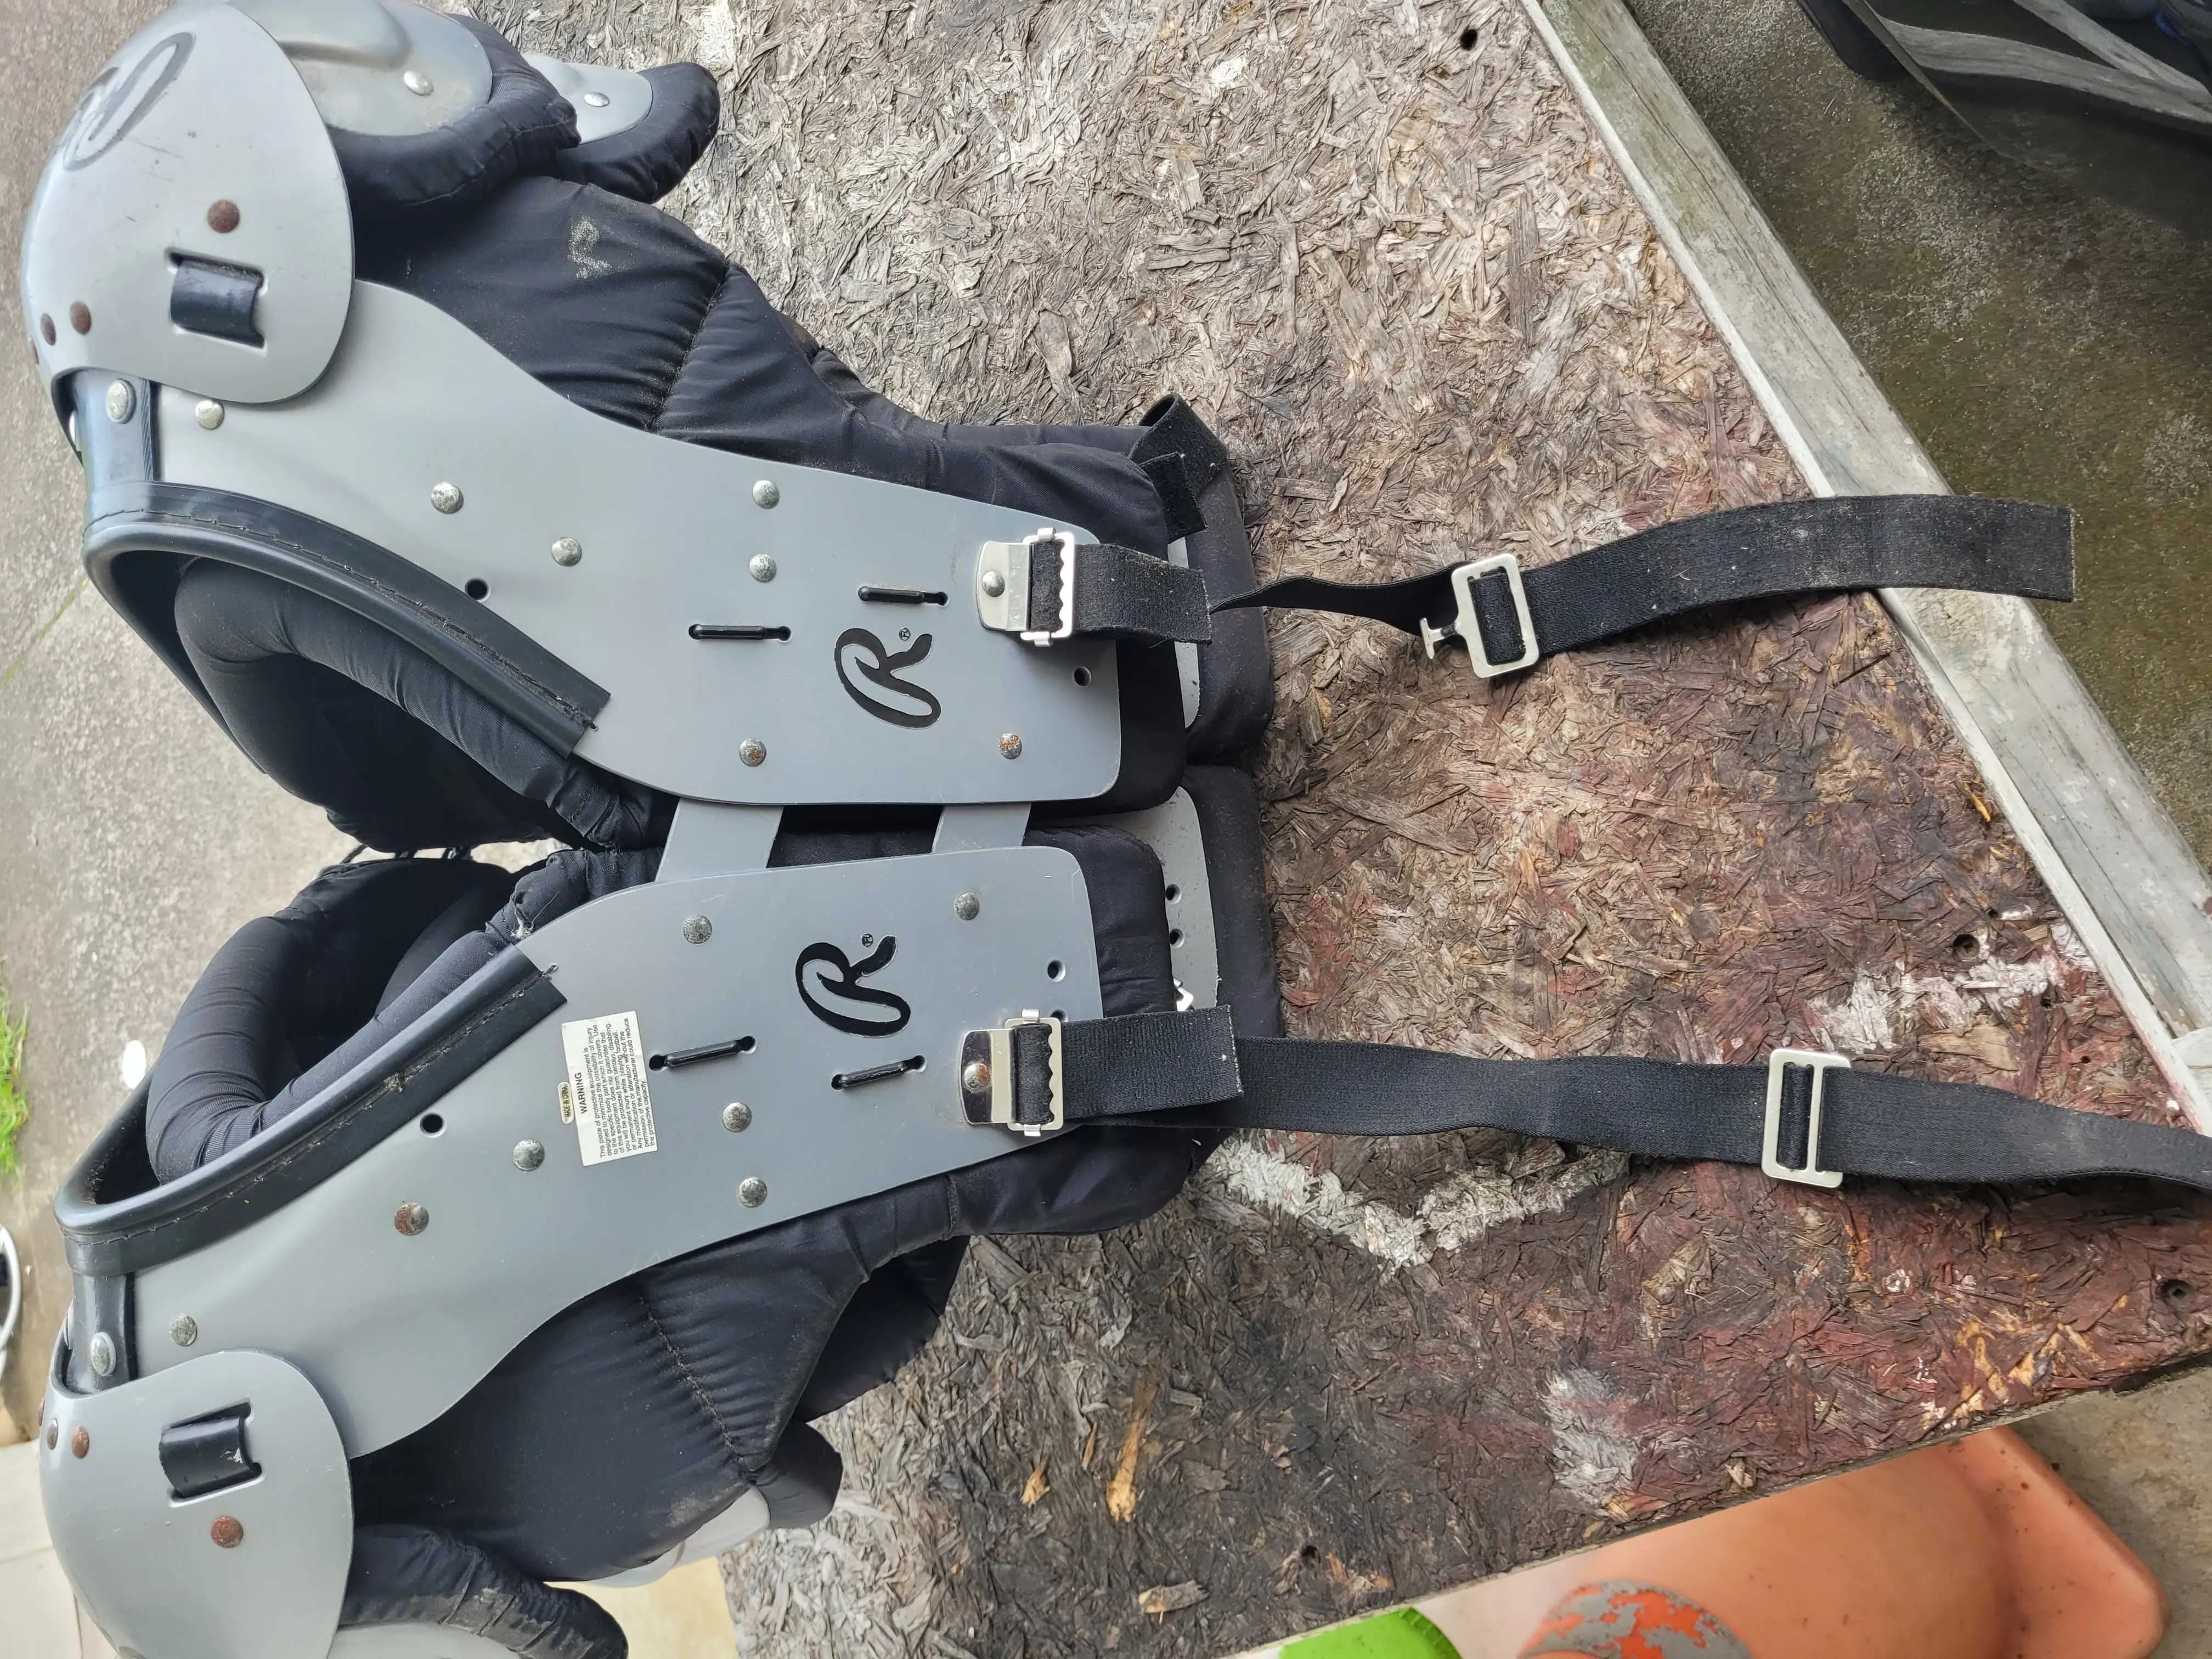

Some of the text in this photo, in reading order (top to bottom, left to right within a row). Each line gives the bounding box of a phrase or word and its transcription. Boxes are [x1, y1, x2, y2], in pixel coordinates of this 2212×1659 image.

[590, 1052, 601, 1081] possibility
[602, 1045, 613, 1074] guarantee
[617, 1054, 627, 1076] playing
[625, 1064, 634, 1091] alteration
[561, 1086, 569, 1099] CHINA
[574, 1072, 588, 1114] WARNING
[591, 1090, 601, 1119] protective
[598, 1093, 606, 1120] minimize
[605, 1098, 613, 1113] body
[616, 1091, 627, 1119] protected
[641, 1081, 649, 1105] capacity
[563, 1105, 571, 1118] MADE
[607, 1114, 616, 1136] specific
[612, 1102, 622, 1134] equipment
[622, 1120, 627, 1128] be
[631, 1100, 641, 1136] modification
[645, 1107, 654, 1135] protective
[627, 1111, 636, 1143] permanent
[640, 1115, 650, 1147] permission
[603, 1128, 612, 1156] designed
